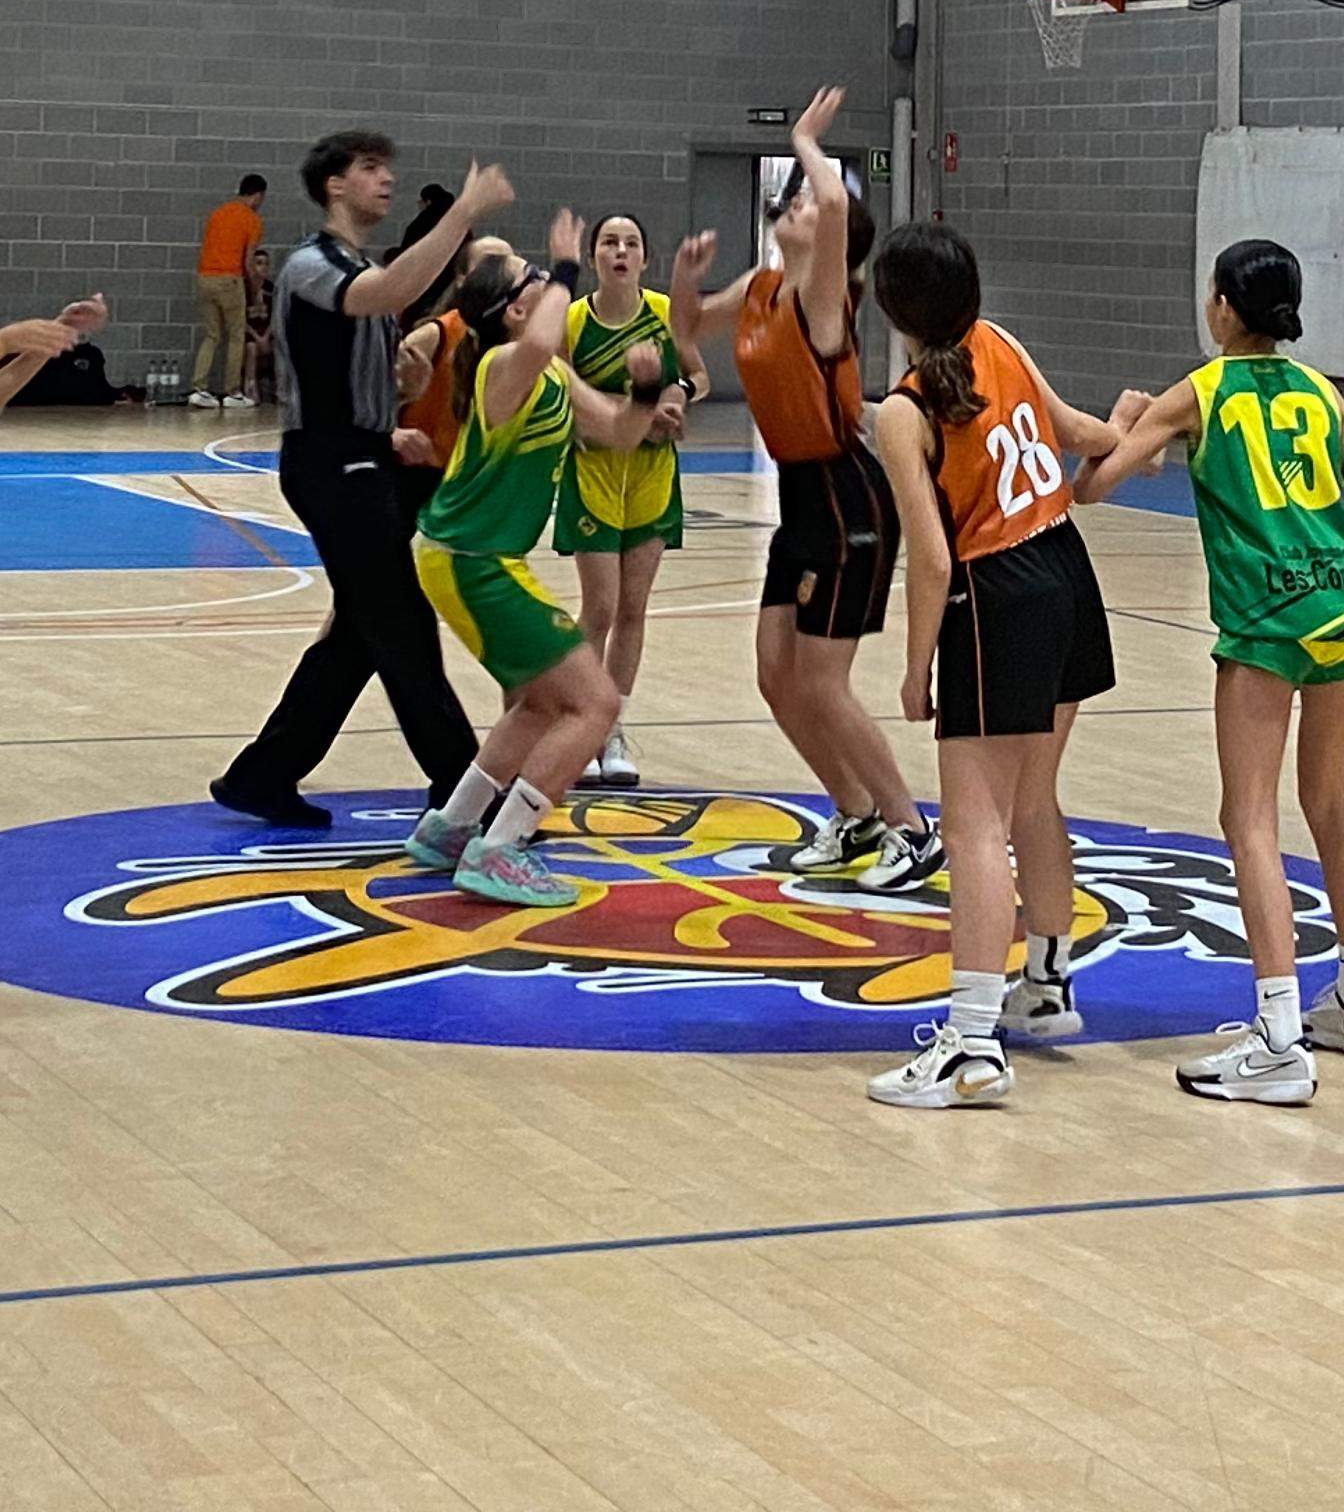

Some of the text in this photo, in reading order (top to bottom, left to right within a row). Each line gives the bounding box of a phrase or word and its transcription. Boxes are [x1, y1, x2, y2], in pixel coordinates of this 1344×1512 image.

[985, 401, 1062, 518] 28
[1218, 391, 1341, 510] 13
[1264, 561, 1310, 594] Les
